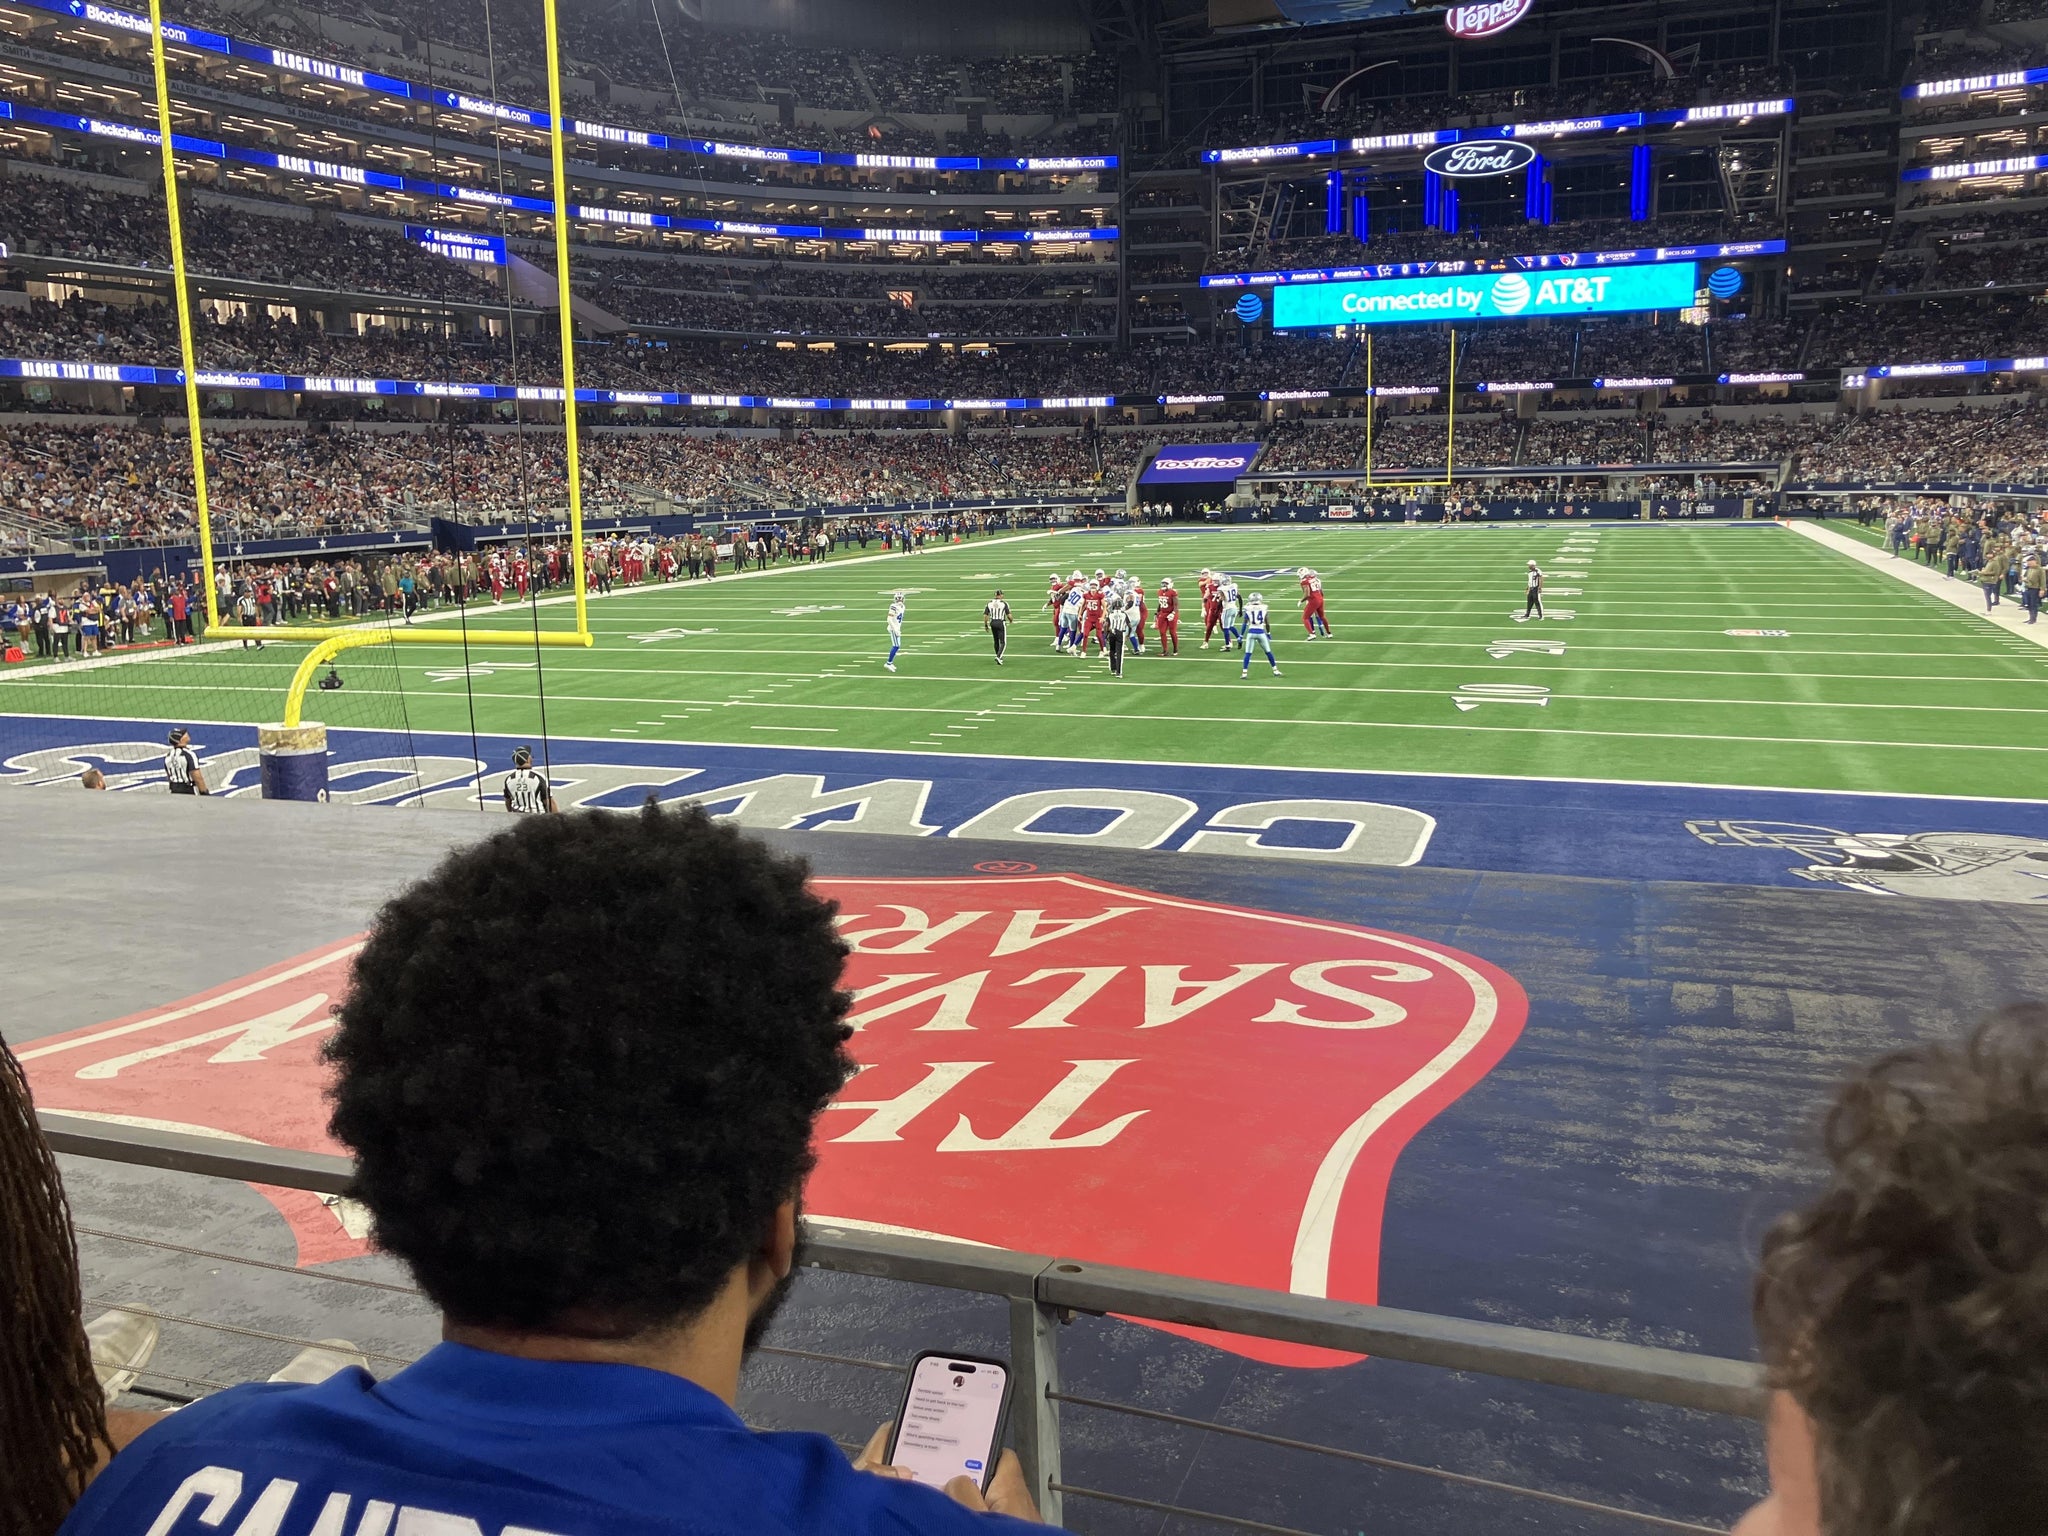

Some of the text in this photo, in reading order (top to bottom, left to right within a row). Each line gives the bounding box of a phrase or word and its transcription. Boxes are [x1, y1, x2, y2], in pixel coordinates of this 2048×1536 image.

[86, 4, 187, 42] Blockchaicom
[273, 50, 364, 85] BLOCK THAT KICK
[1919, 71, 2025, 97] BLOCK THAT KICK
[459, 96, 530, 123] Blockchain.com
[1688, 100, 1787, 119] BLOCK THAT KICK
[576, 121, 649, 145] BLOCK THAT KICK
[1515, 119, 1601, 136] Blockchain.com
[1352, 132, 1435, 149] BLOCK THAT KICK
[715, 143, 788, 160] Blockchain.com
[1221, 145, 1298, 161] Blockchain.com
[1445, 145, 1514, 172] Ford
[278, 154, 365, 183] BLOCK THAT KICK
[857, 154, 936, 168] BLOCK THAT KICK
[1028, 157, 1105, 170] Blockchain.com
[1931, 156, 2036, 179] BLOCK THAT KICK
[580, 206, 652, 226] BLOCK THAT KICK
[723, 222, 777, 234] Blockchain.com
[864, 228, 941, 242] BLOCK THAT KICK
[1033, 231, 1090, 241] Blockchain.com
[451, 245, 473, 260] THAT
[475, 248, 494, 262] KICK
[1402, 264, 1409, 274] 0
[1438, 261, 1465, 272] 12:17
[1535, 275, 1611, 305] AT&T
[1342, 287, 1484, 313] Connected by
[21, 361, 120, 381] BLOCK THAT KICK
[193, 372, 260, 386] lockchain.com
[1730, 372, 1803, 383] Blockchain.com
[1487, 381, 1554, 391] Blockchain.com
[1605, 377, 1673, 387] Blockchain.com
[1268, 390, 1329, 400] Blockchain.com
[1376, 385, 1439, 396] Blockchain.com
[1167, 394, 1224, 404] Blockchain.com
[1227, 588, 1237, 603] 18
[1251, 610, 1264, 625] 14
[515, 783, 529, 792] 23
[826, 1058, 1151, 1153] TH
